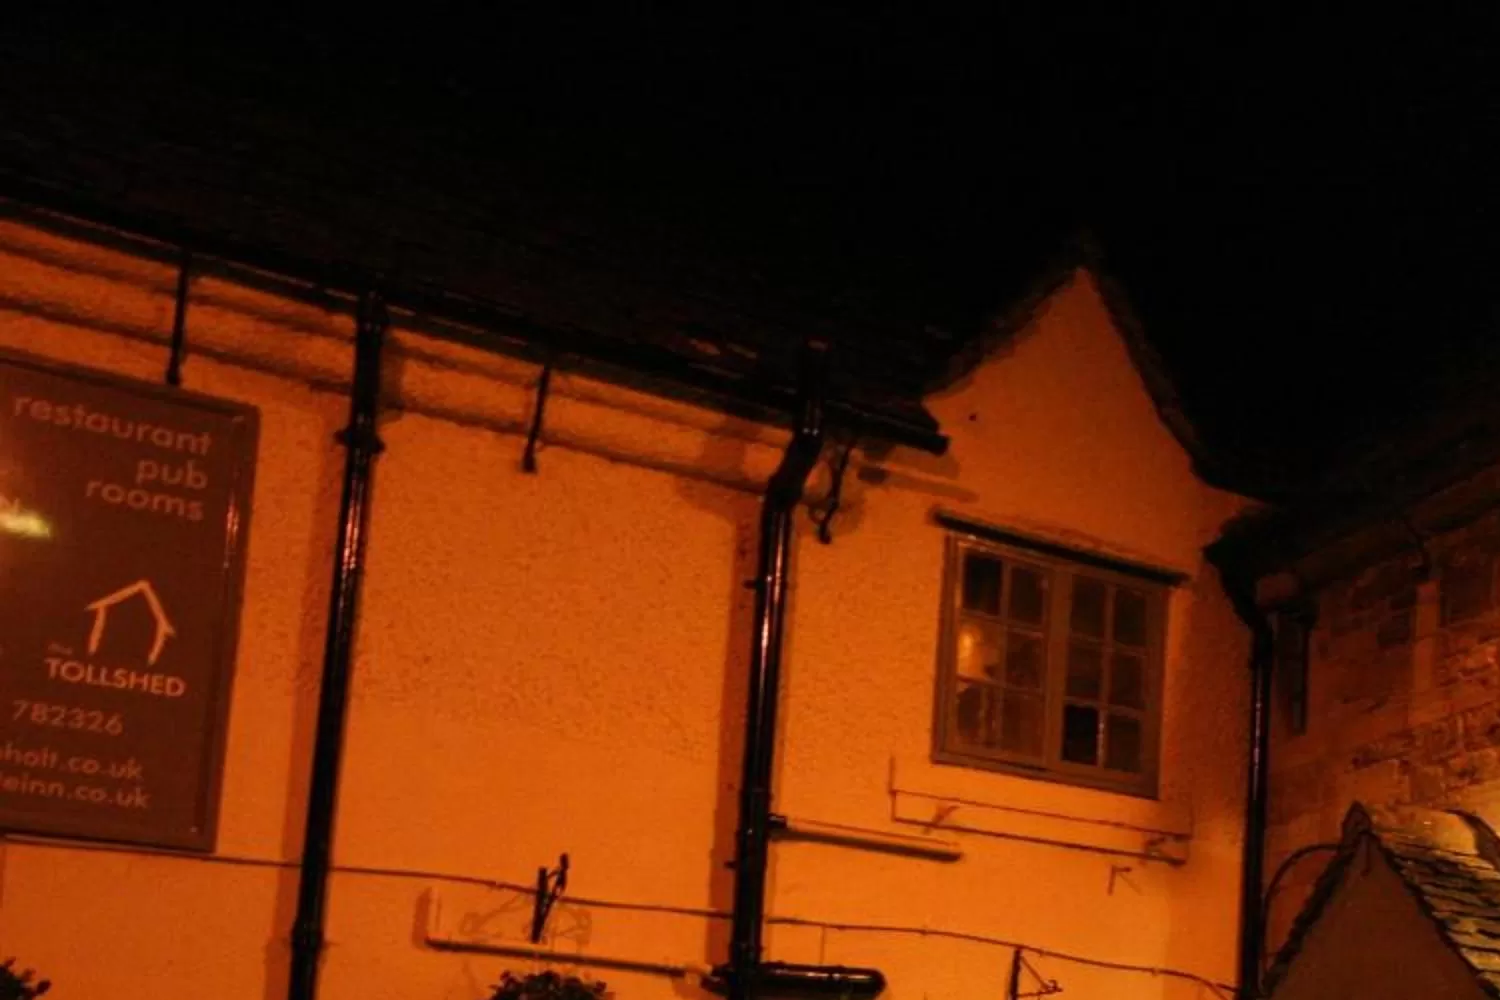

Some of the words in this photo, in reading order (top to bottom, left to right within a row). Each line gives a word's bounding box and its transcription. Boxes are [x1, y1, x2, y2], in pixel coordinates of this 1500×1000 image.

[14, 396, 212, 456] restaurant
[135, 458, 209, 490] pub
[85, 479, 205, 521] rooms
[44, 657, 188, 697] TOLLSHED
[12, 699, 124, 736] 782326
[0, 740, 143, 779] holt.co.uk
[0, 772, 151, 808] einn.co.uk
